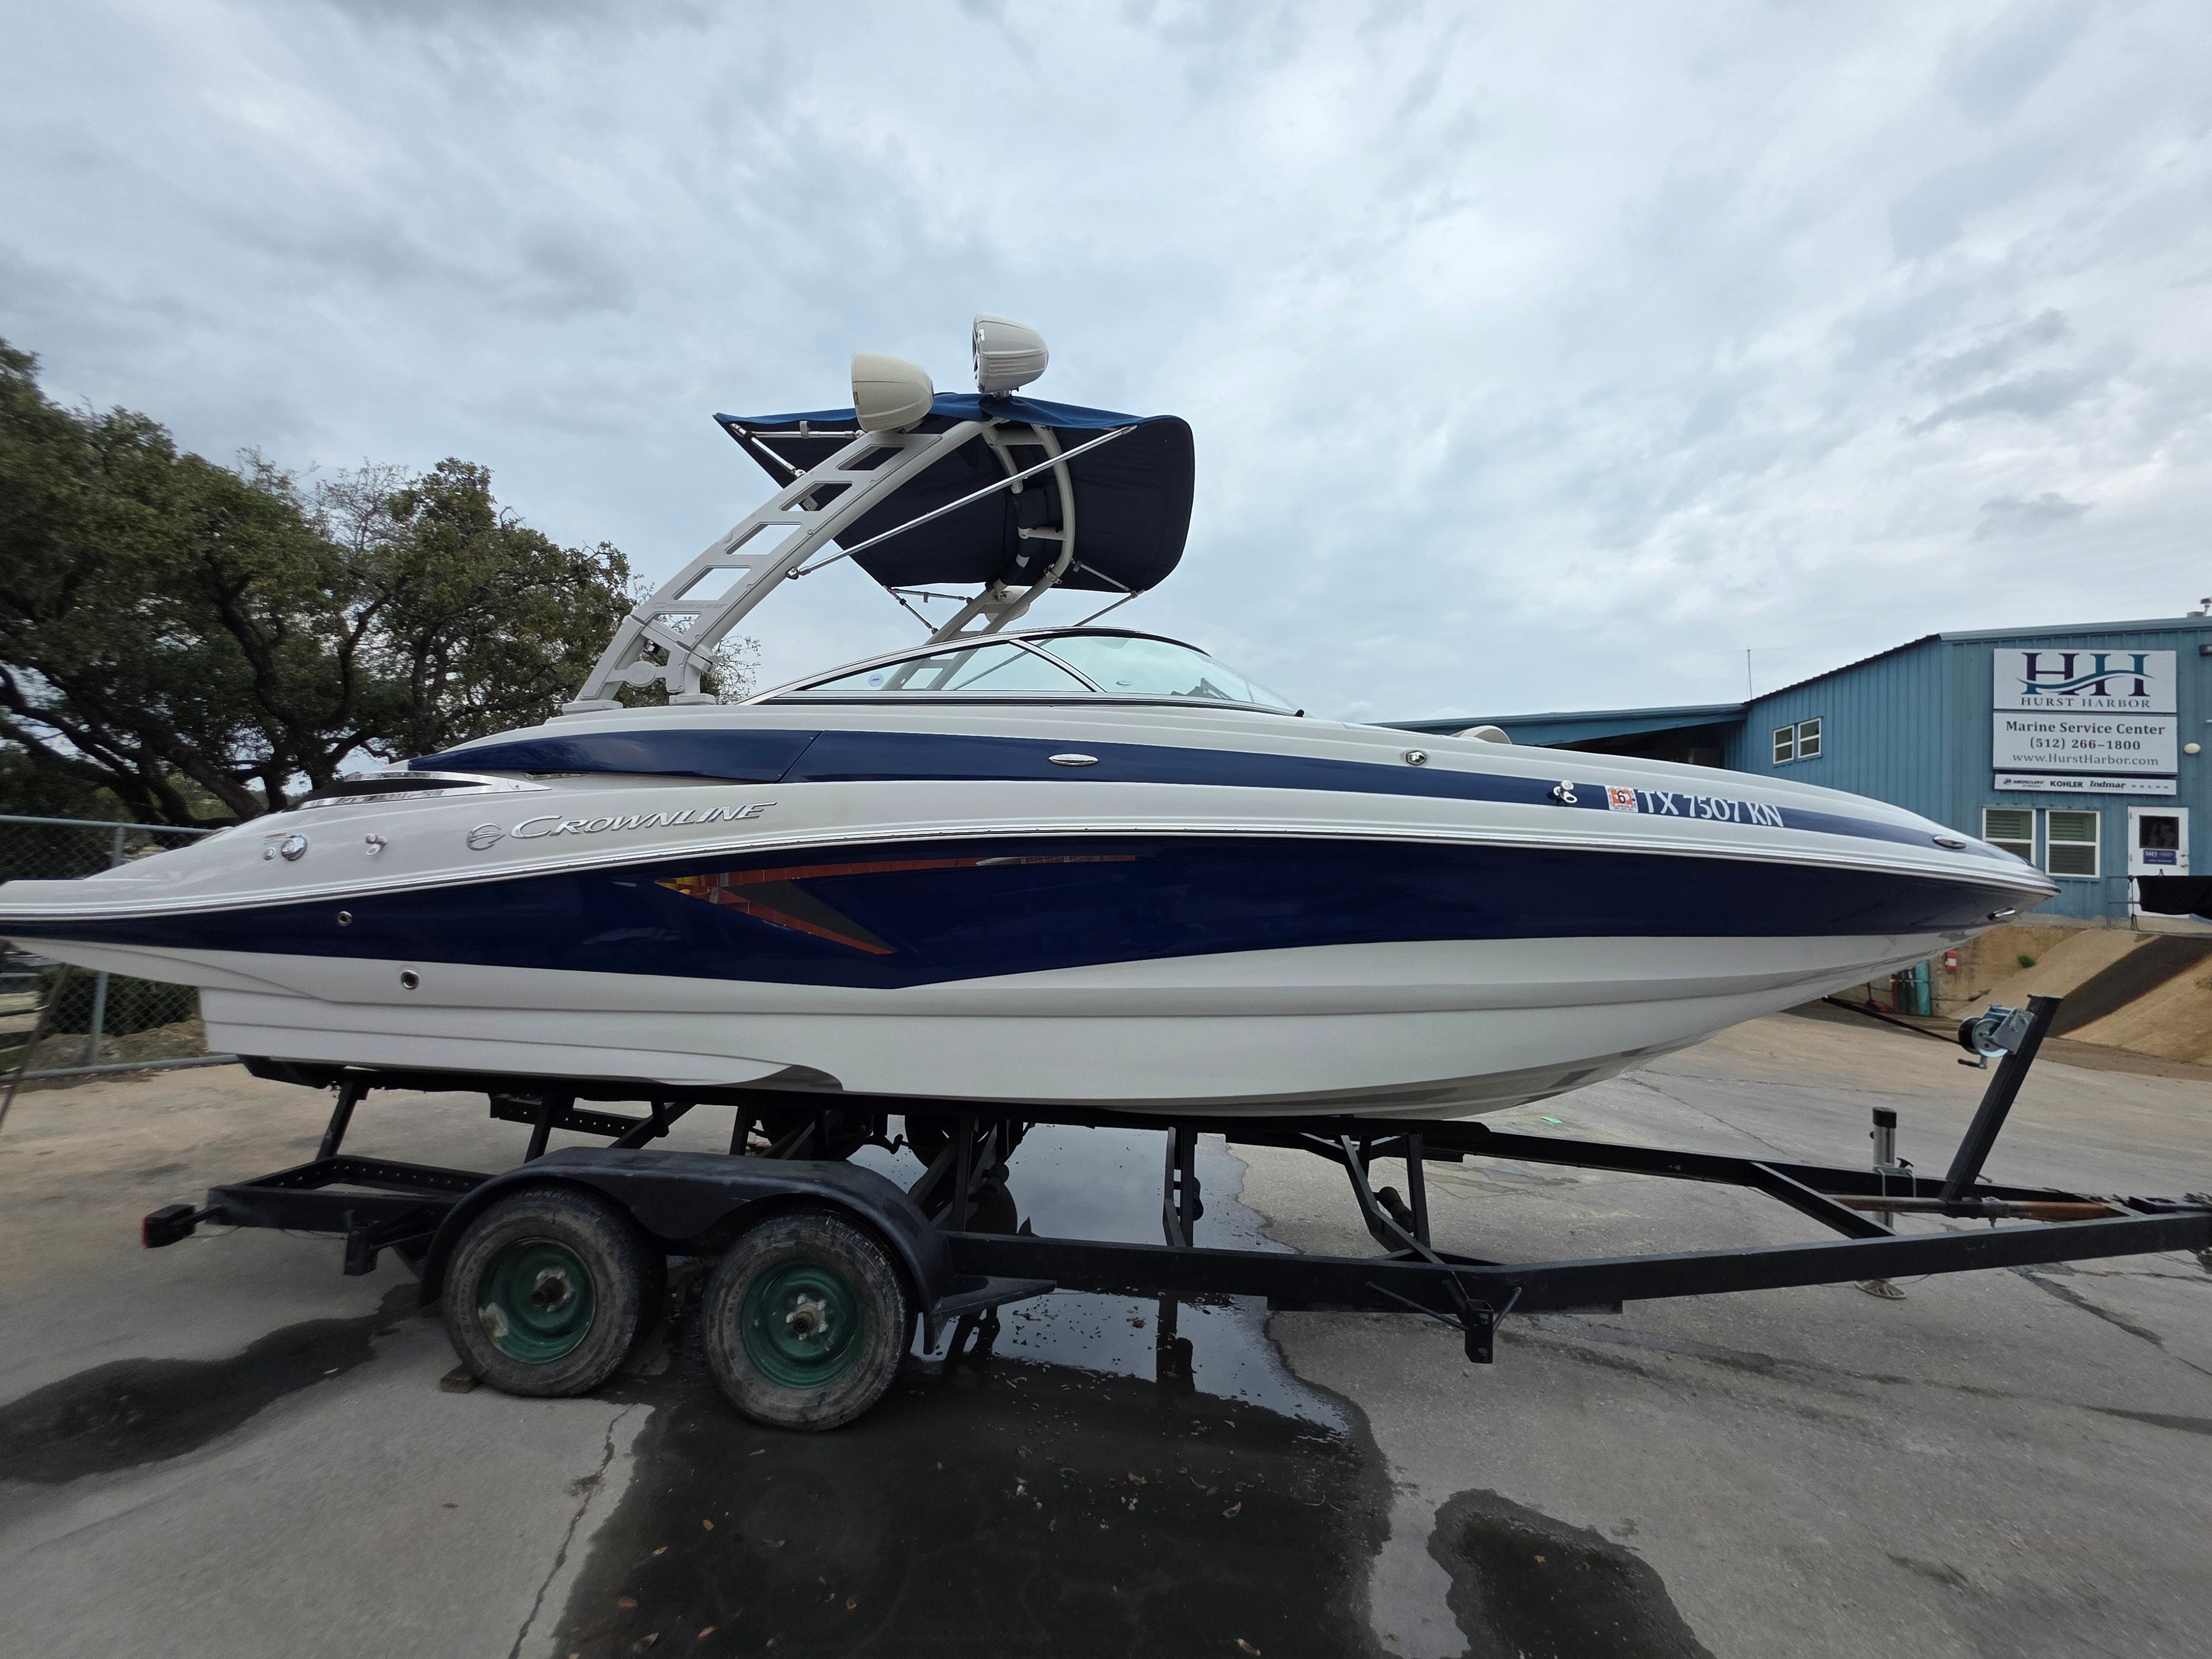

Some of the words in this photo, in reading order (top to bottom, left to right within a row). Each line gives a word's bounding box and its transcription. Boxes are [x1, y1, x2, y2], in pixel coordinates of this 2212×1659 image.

[2021, 697, 2074, 707] HURST
[2082, 698, 2150, 708] HARBOR
[2006, 721, 2056, 733] Marine
[2059, 722, 2112, 734] Service
[2116, 723, 2165, 735] Center
[2030, 737, 2065, 750] (512)
[2072, 739, 2141, 750] 266-1800
[2012, 753, 2159, 766] www.HurstHarbor.com
[1617, 790, 1626, 804] 6
[1637, 790, 1679, 815] TX
[1683, 794, 1741, 822] 7507
[1746, 801, 1784, 827] KN
[510, 801, 778, 839] CROWNLINE
